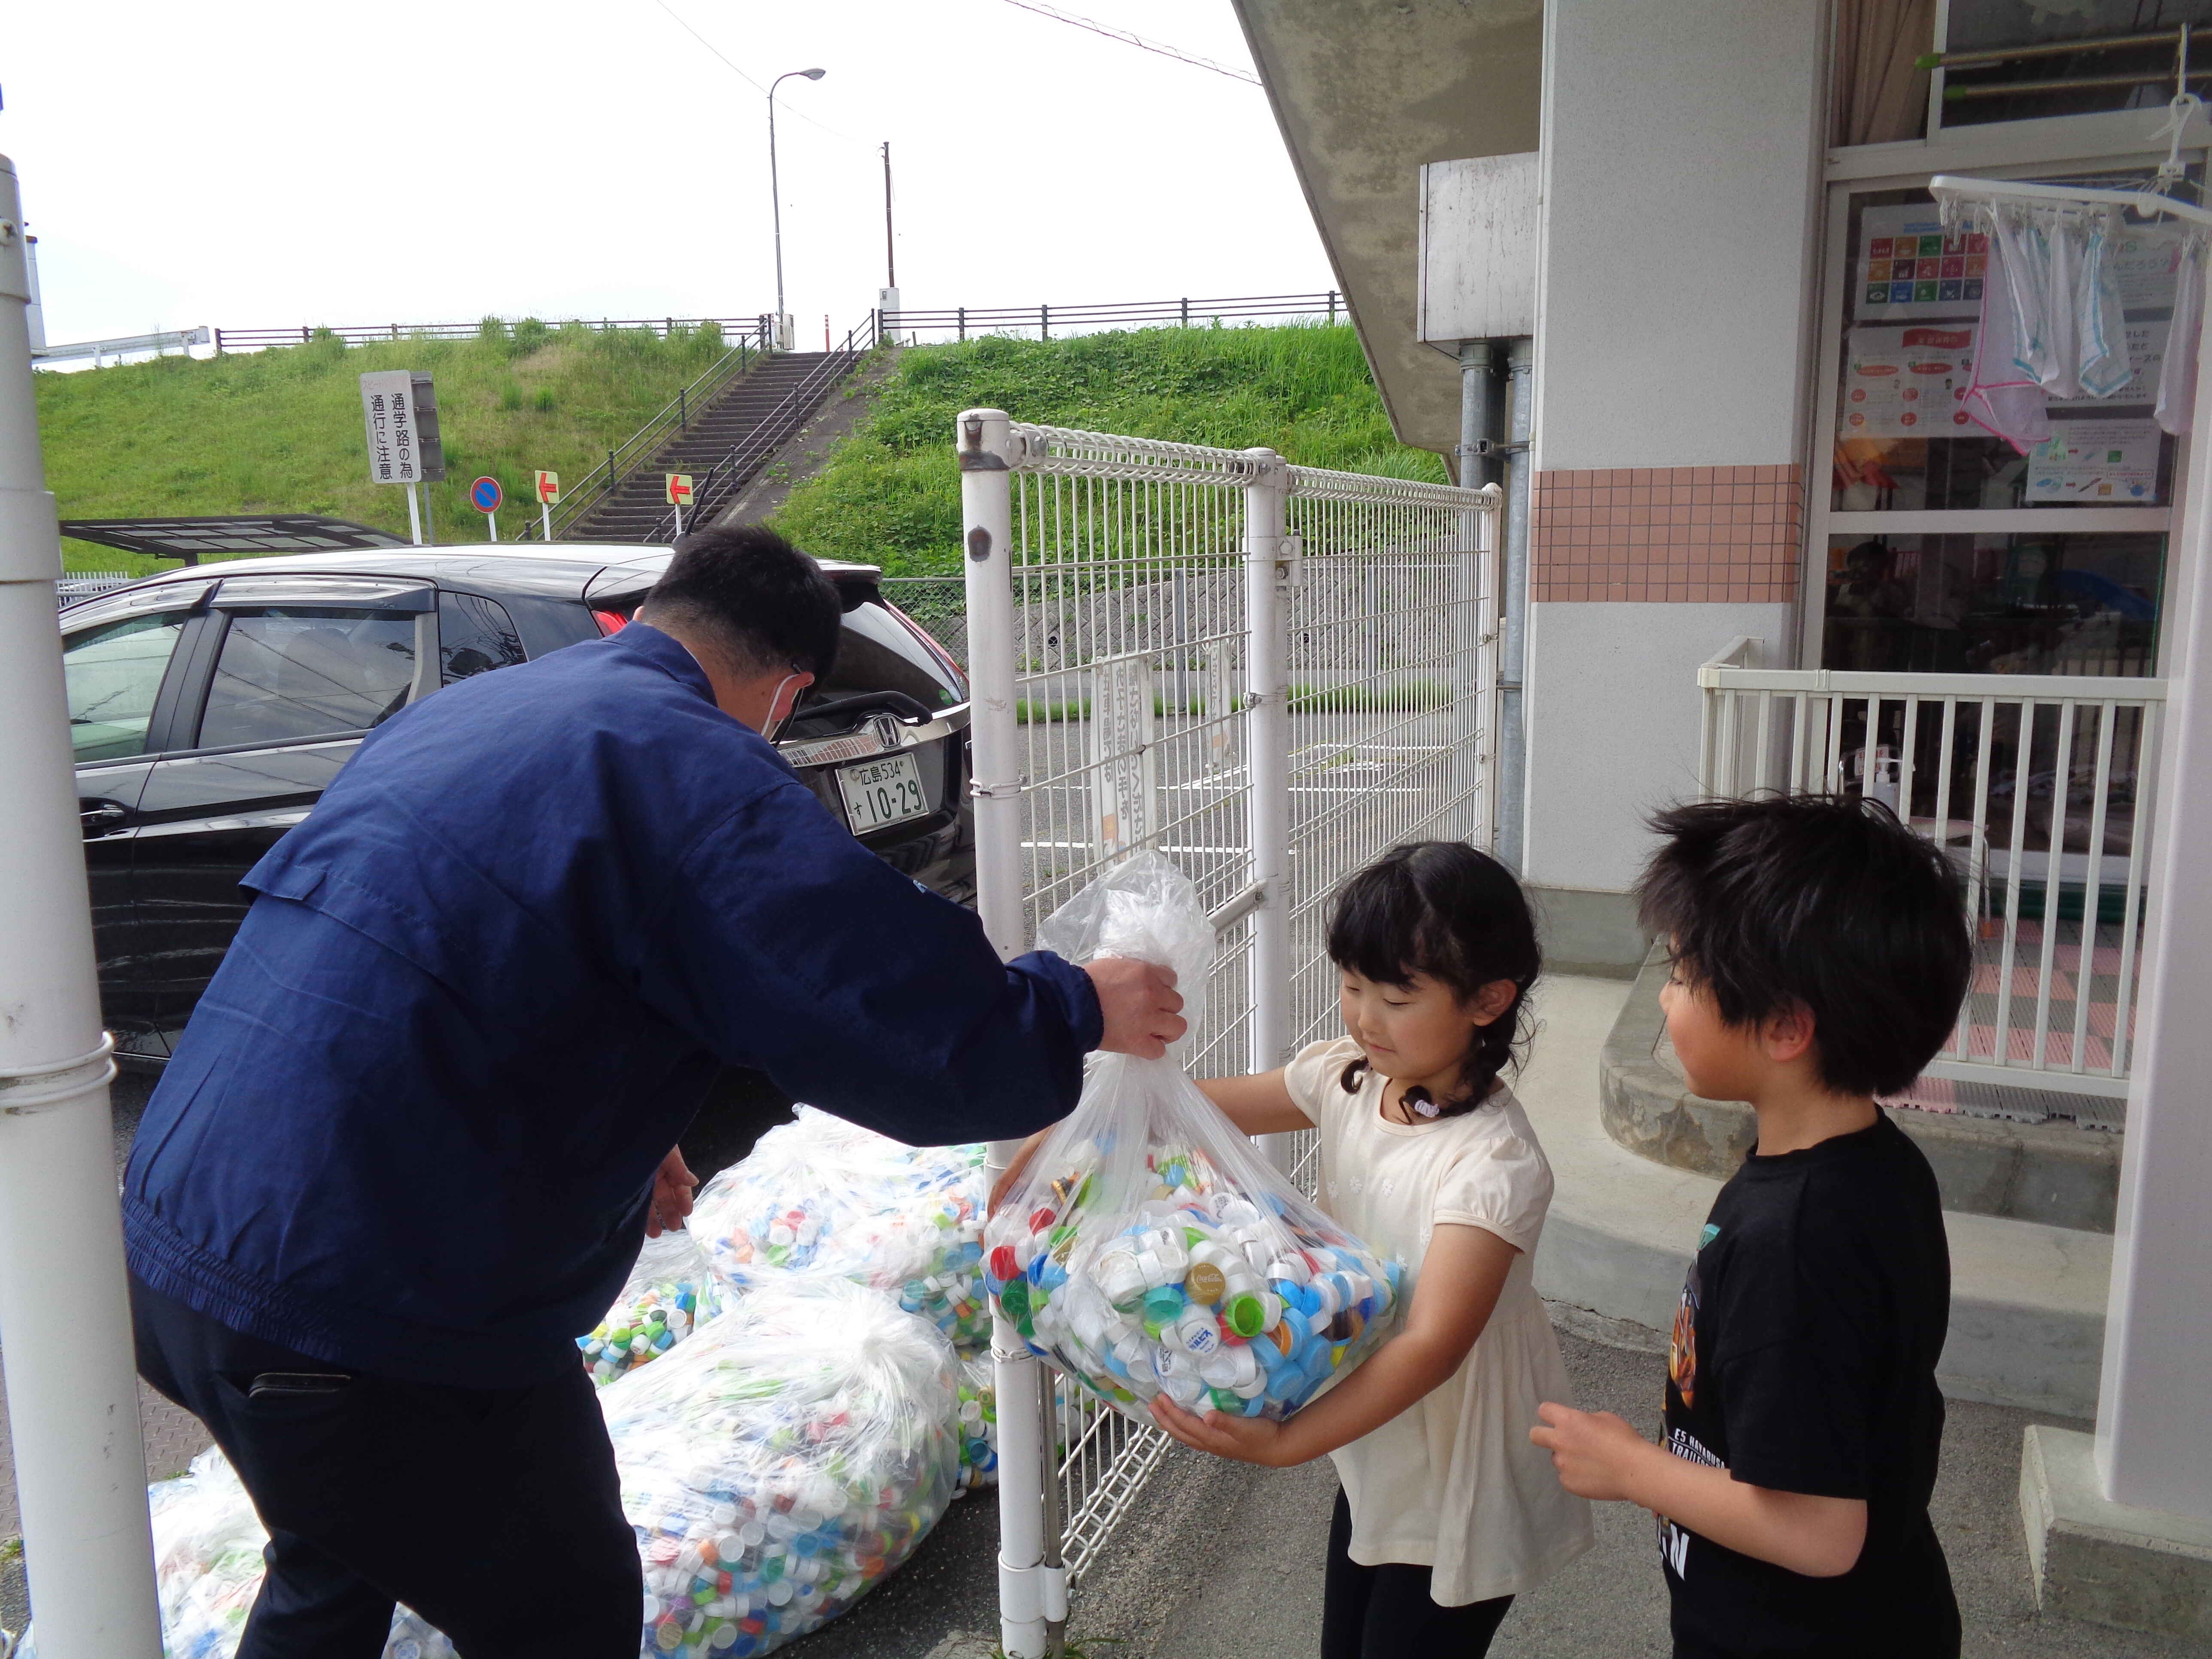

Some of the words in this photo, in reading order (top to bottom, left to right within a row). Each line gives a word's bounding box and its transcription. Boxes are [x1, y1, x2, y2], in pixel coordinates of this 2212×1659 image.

[371, 394, 392, 480] 通行に注意
[391, 393, 413, 479] 通学路の為
[1674, 1428, 1687, 1443] E5
[1689, 1435, 1725, 1469] HAYABUSA
